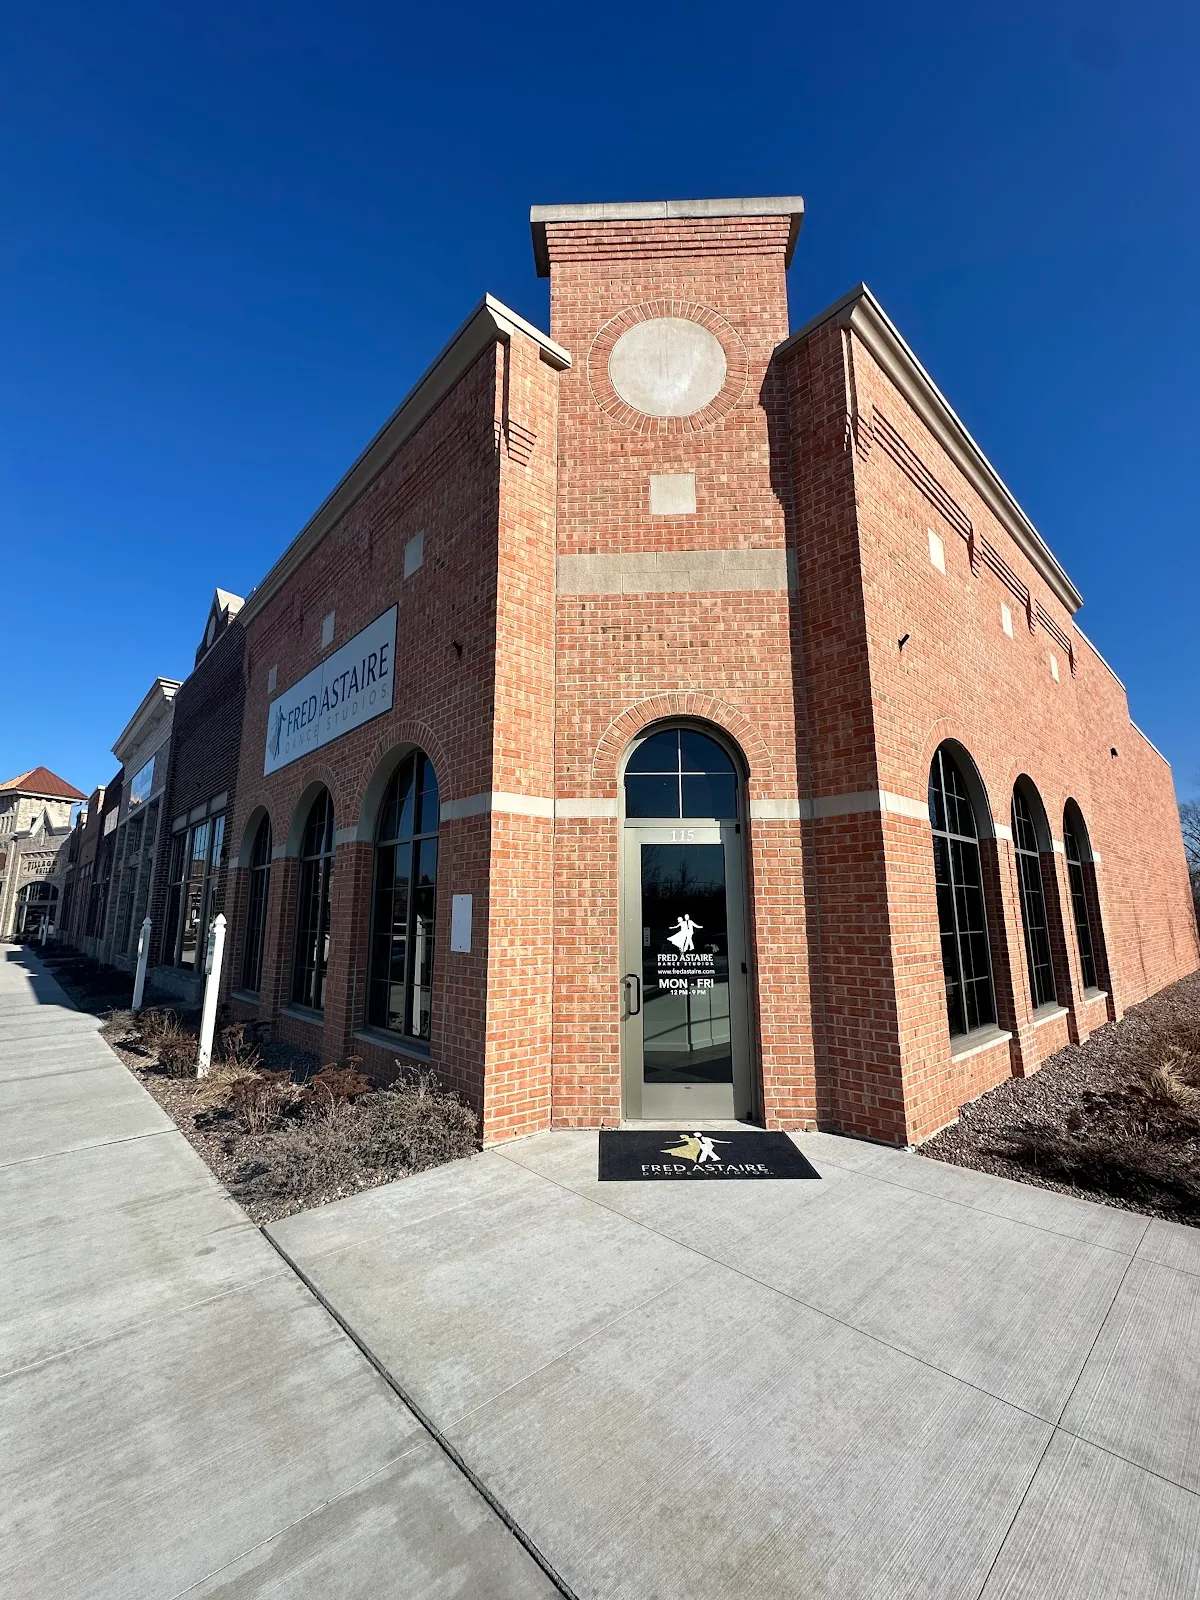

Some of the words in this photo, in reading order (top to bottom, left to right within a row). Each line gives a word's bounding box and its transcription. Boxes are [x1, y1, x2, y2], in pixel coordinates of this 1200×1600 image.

[286, 695, 318, 737] FRED
[319, 642, 389, 715] ASTAIRE
[326, 683, 388, 731] STUDIOS
[671, 830, 695, 841] 115
[658, 978, 688, 989] MON
[697, 978, 714, 989] FRI
[641, 1164, 686, 1172] FRED
[692, 1164, 769, 1172] ASTAIRE
